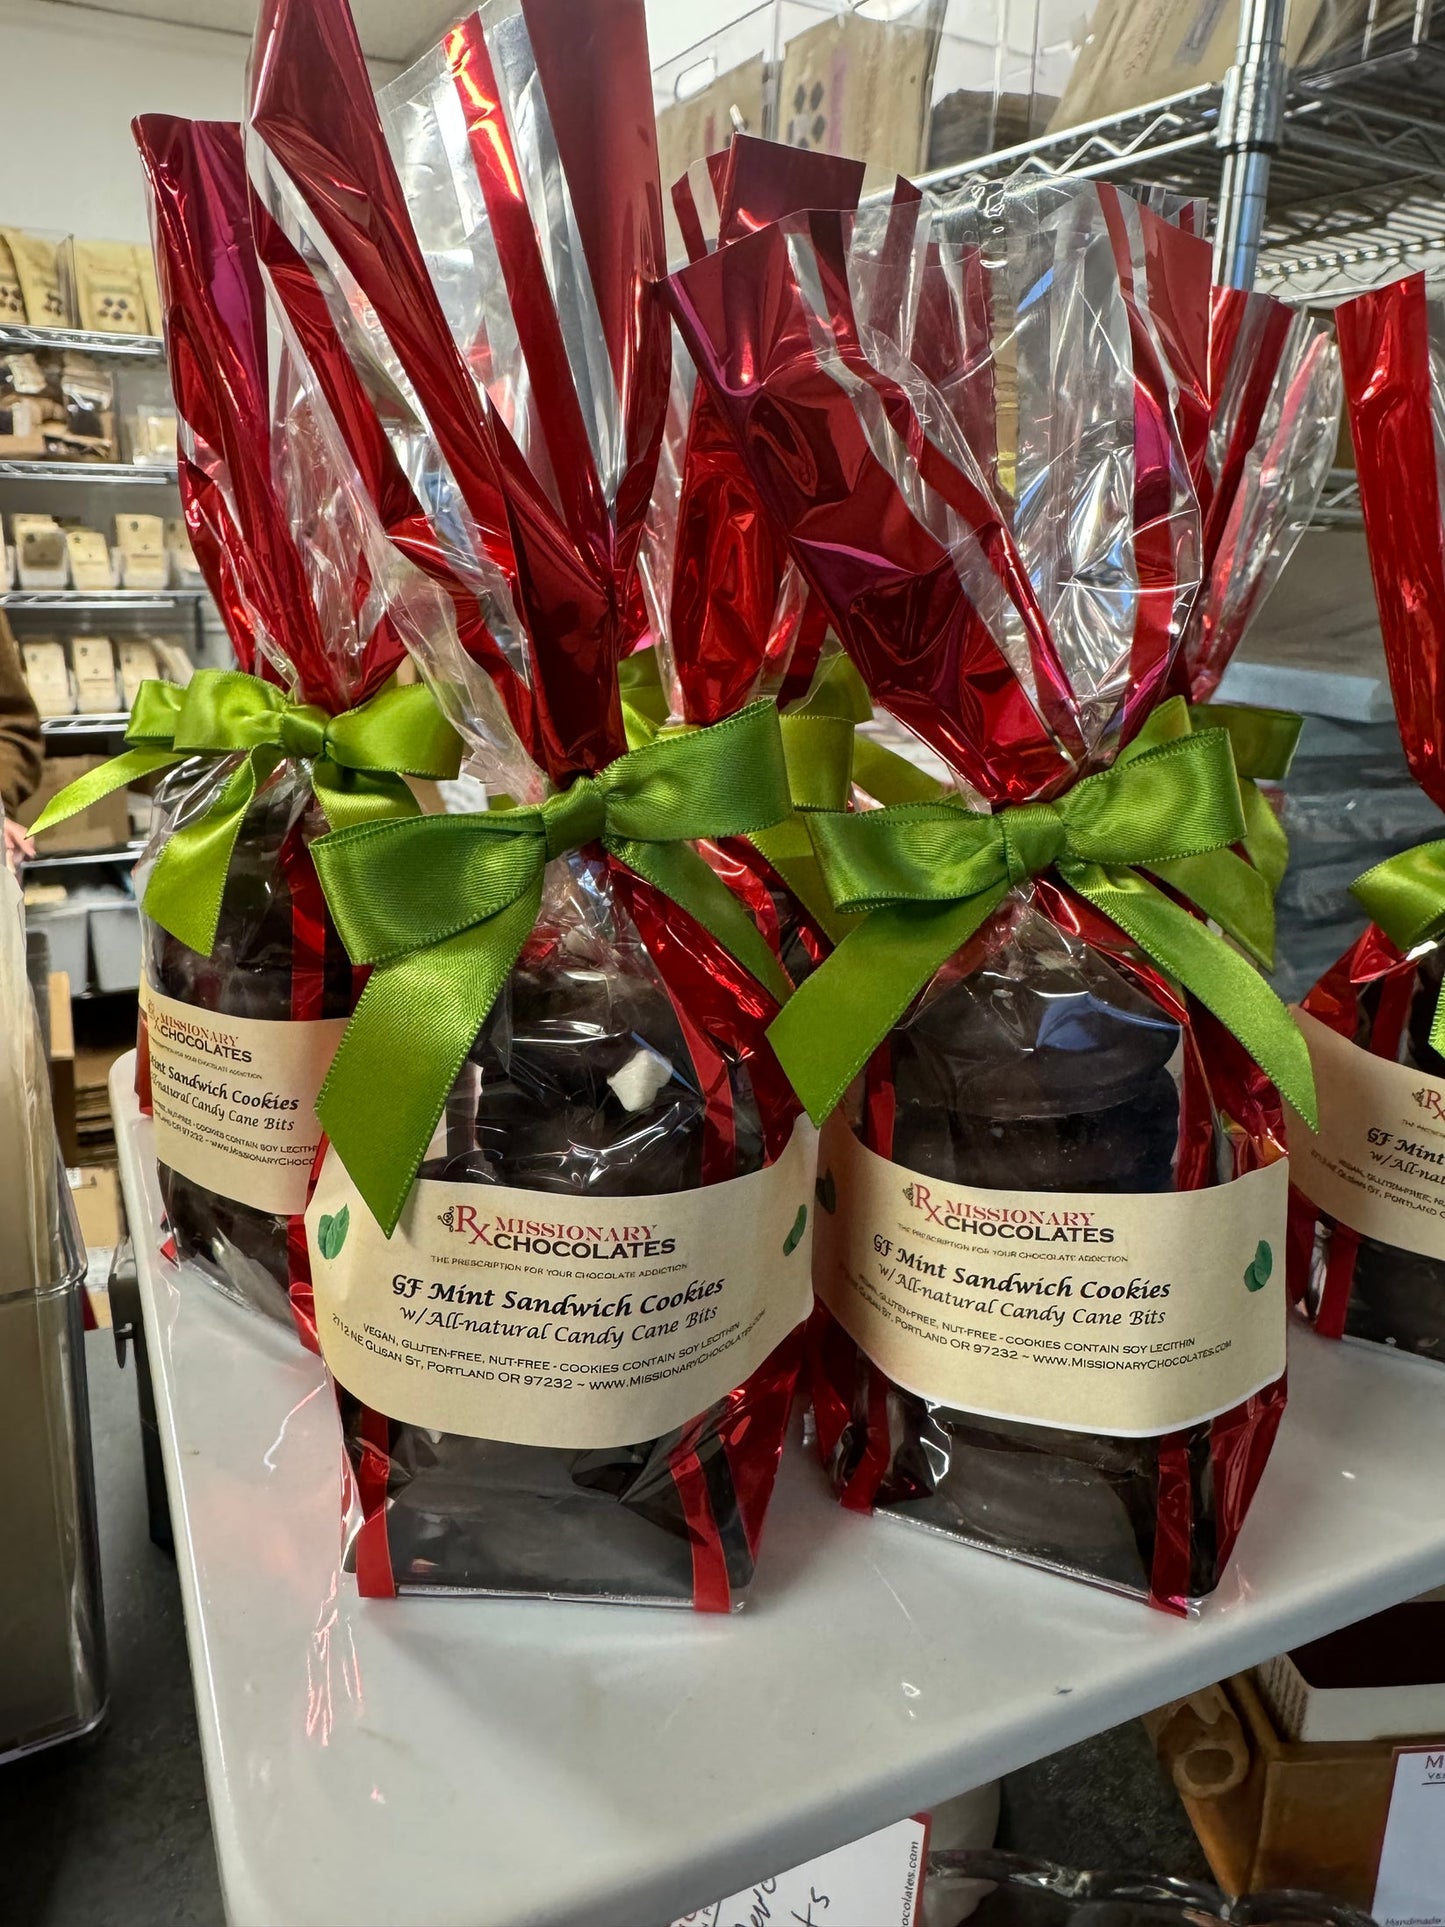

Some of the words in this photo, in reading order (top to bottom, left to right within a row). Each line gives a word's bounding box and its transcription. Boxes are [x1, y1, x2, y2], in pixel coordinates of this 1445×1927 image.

[160, 1012, 239, 1047] MISSIONARY
[160, 1025, 252, 1063] CHOCOLATES
[168, 1066, 228, 1099] Sandwich
[231, 1090, 300, 1110] Cookies
[191, 1096, 225, 1121] Candy
[228, 1109, 258, 1127] Cane
[263, 1117, 295, 1131] Bits
[280, 1144, 316, 1154] LECITH
[1367, 1127, 1394, 1146] GF
[1394, 1139, 1445, 1165] Mint
[495, 1216, 658, 1243] MISSIONARY
[944, 1215, 1114, 1243] CHOCOLATES
[945, 1199, 1096, 1227] MISSIONARY
[493, 1233, 676, 1260] CHOCOLATES
[431, 1255, 450, 1264] THE
[546, 1269, 573, 1279] YOUR
[575, 1271, 636, 1280] CHOCOLATE
[638, 1263, 688, 1278] ADDICTION
[873, 1234, 894, 1257] GF
[895, 1248, 947, 1279] Mint
[952, 1267, 1073, 1297] Sandwich
[1080, 1277, 1171, 1300] Cookies
[392, 1274, 424, 1299] GF
[427, 1283, 496, 1307] Mint
[501, 1290, 633, 1318] Sandwich
[639, 1277, 726, 1314] Cookies
[878, 1263, 1000, 1313] w/All-natural
[1000, 1302, 1065, 1327] Candy
[1072, 1308, 1122, 1325] Cane
[1129, 1309, 1166, 1325] Bits
[399, 1306, 553, 1341] w/All-natural
[554, 1326, 624, 1349] Candy
[631, 1319, 679, 1341] Cane
[685, 1305, 718, 1329] Bits
[942, 1322, 997, 1341] NUT-FREE
[1005, 1336, 1061, 1350] COOKIES
[1064, 1342, 1119, 1353] CONTAIN
[1122, 1345, 1147, 1354] SOY
[1149, 1337, 1196, 1353] LECITHIN
[351, 1330, 364, 1347] NE
[427, 1361, 495, 1381] PORTLAND
[498, 1372, 520, 1385] OR
[523, 1375, 573, 1389] 97232
[363, 1323, 399, 1346] VEGAN,
[401, 1339, 485, 1364] GLUTEN-FREE,
[489, 1354, 550, 1371] NUT-FREE
[559, 1363, 619, 1374] COOKIES
[622, 1352, 675, 1372] CONTAIN
[678, 1342, 700, 1359] SOY
[701, 1321, 740, 1350] LECITHIN
[950, 1338, 970, 1351] OR
[973, 1343, 1018, 1360] 97232
[901, 1841, 919, 1927] ocolates.com
